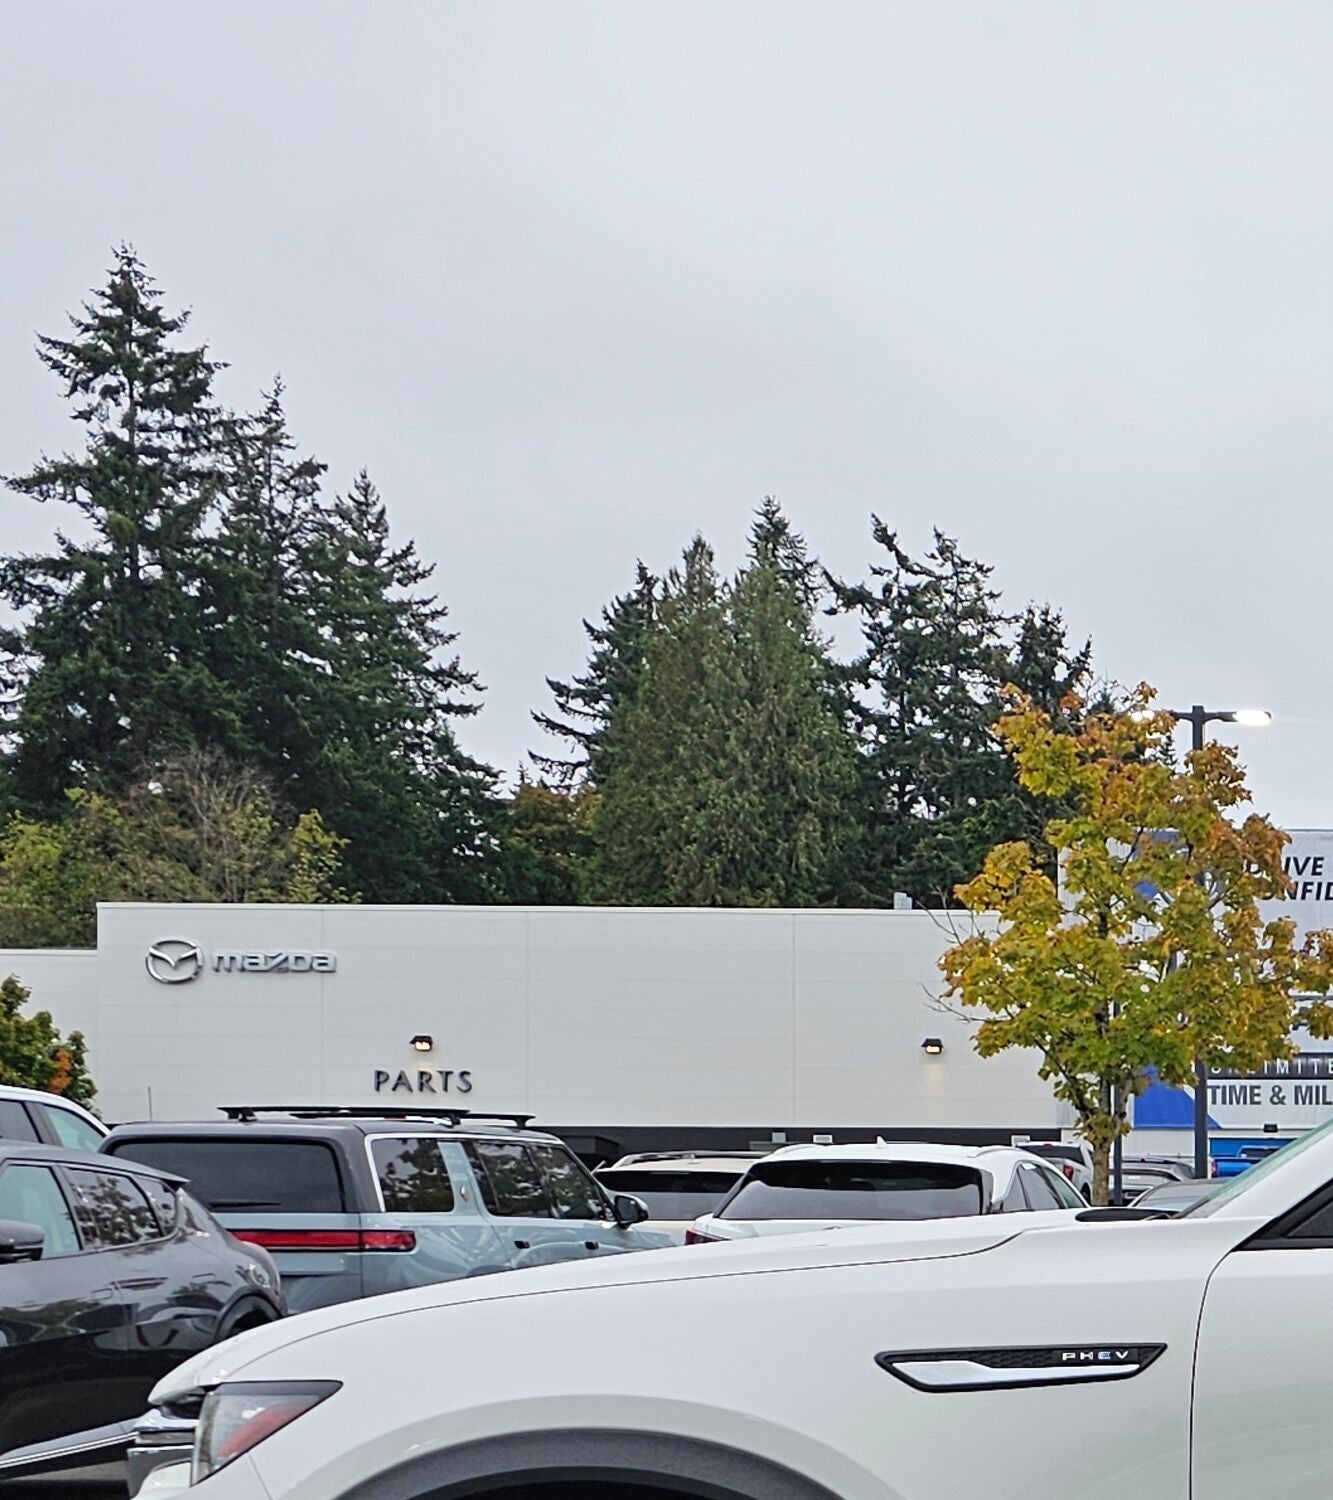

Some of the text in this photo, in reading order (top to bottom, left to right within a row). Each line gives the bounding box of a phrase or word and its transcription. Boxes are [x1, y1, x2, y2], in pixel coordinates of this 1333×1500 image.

[373, 1070, 473, 1093] PARTS
[1208, 1085, 1261, 1106] TIME
[1269, 1085, 1286, 1106] &
[1062, 1350, 1129, 1361] PHEV
